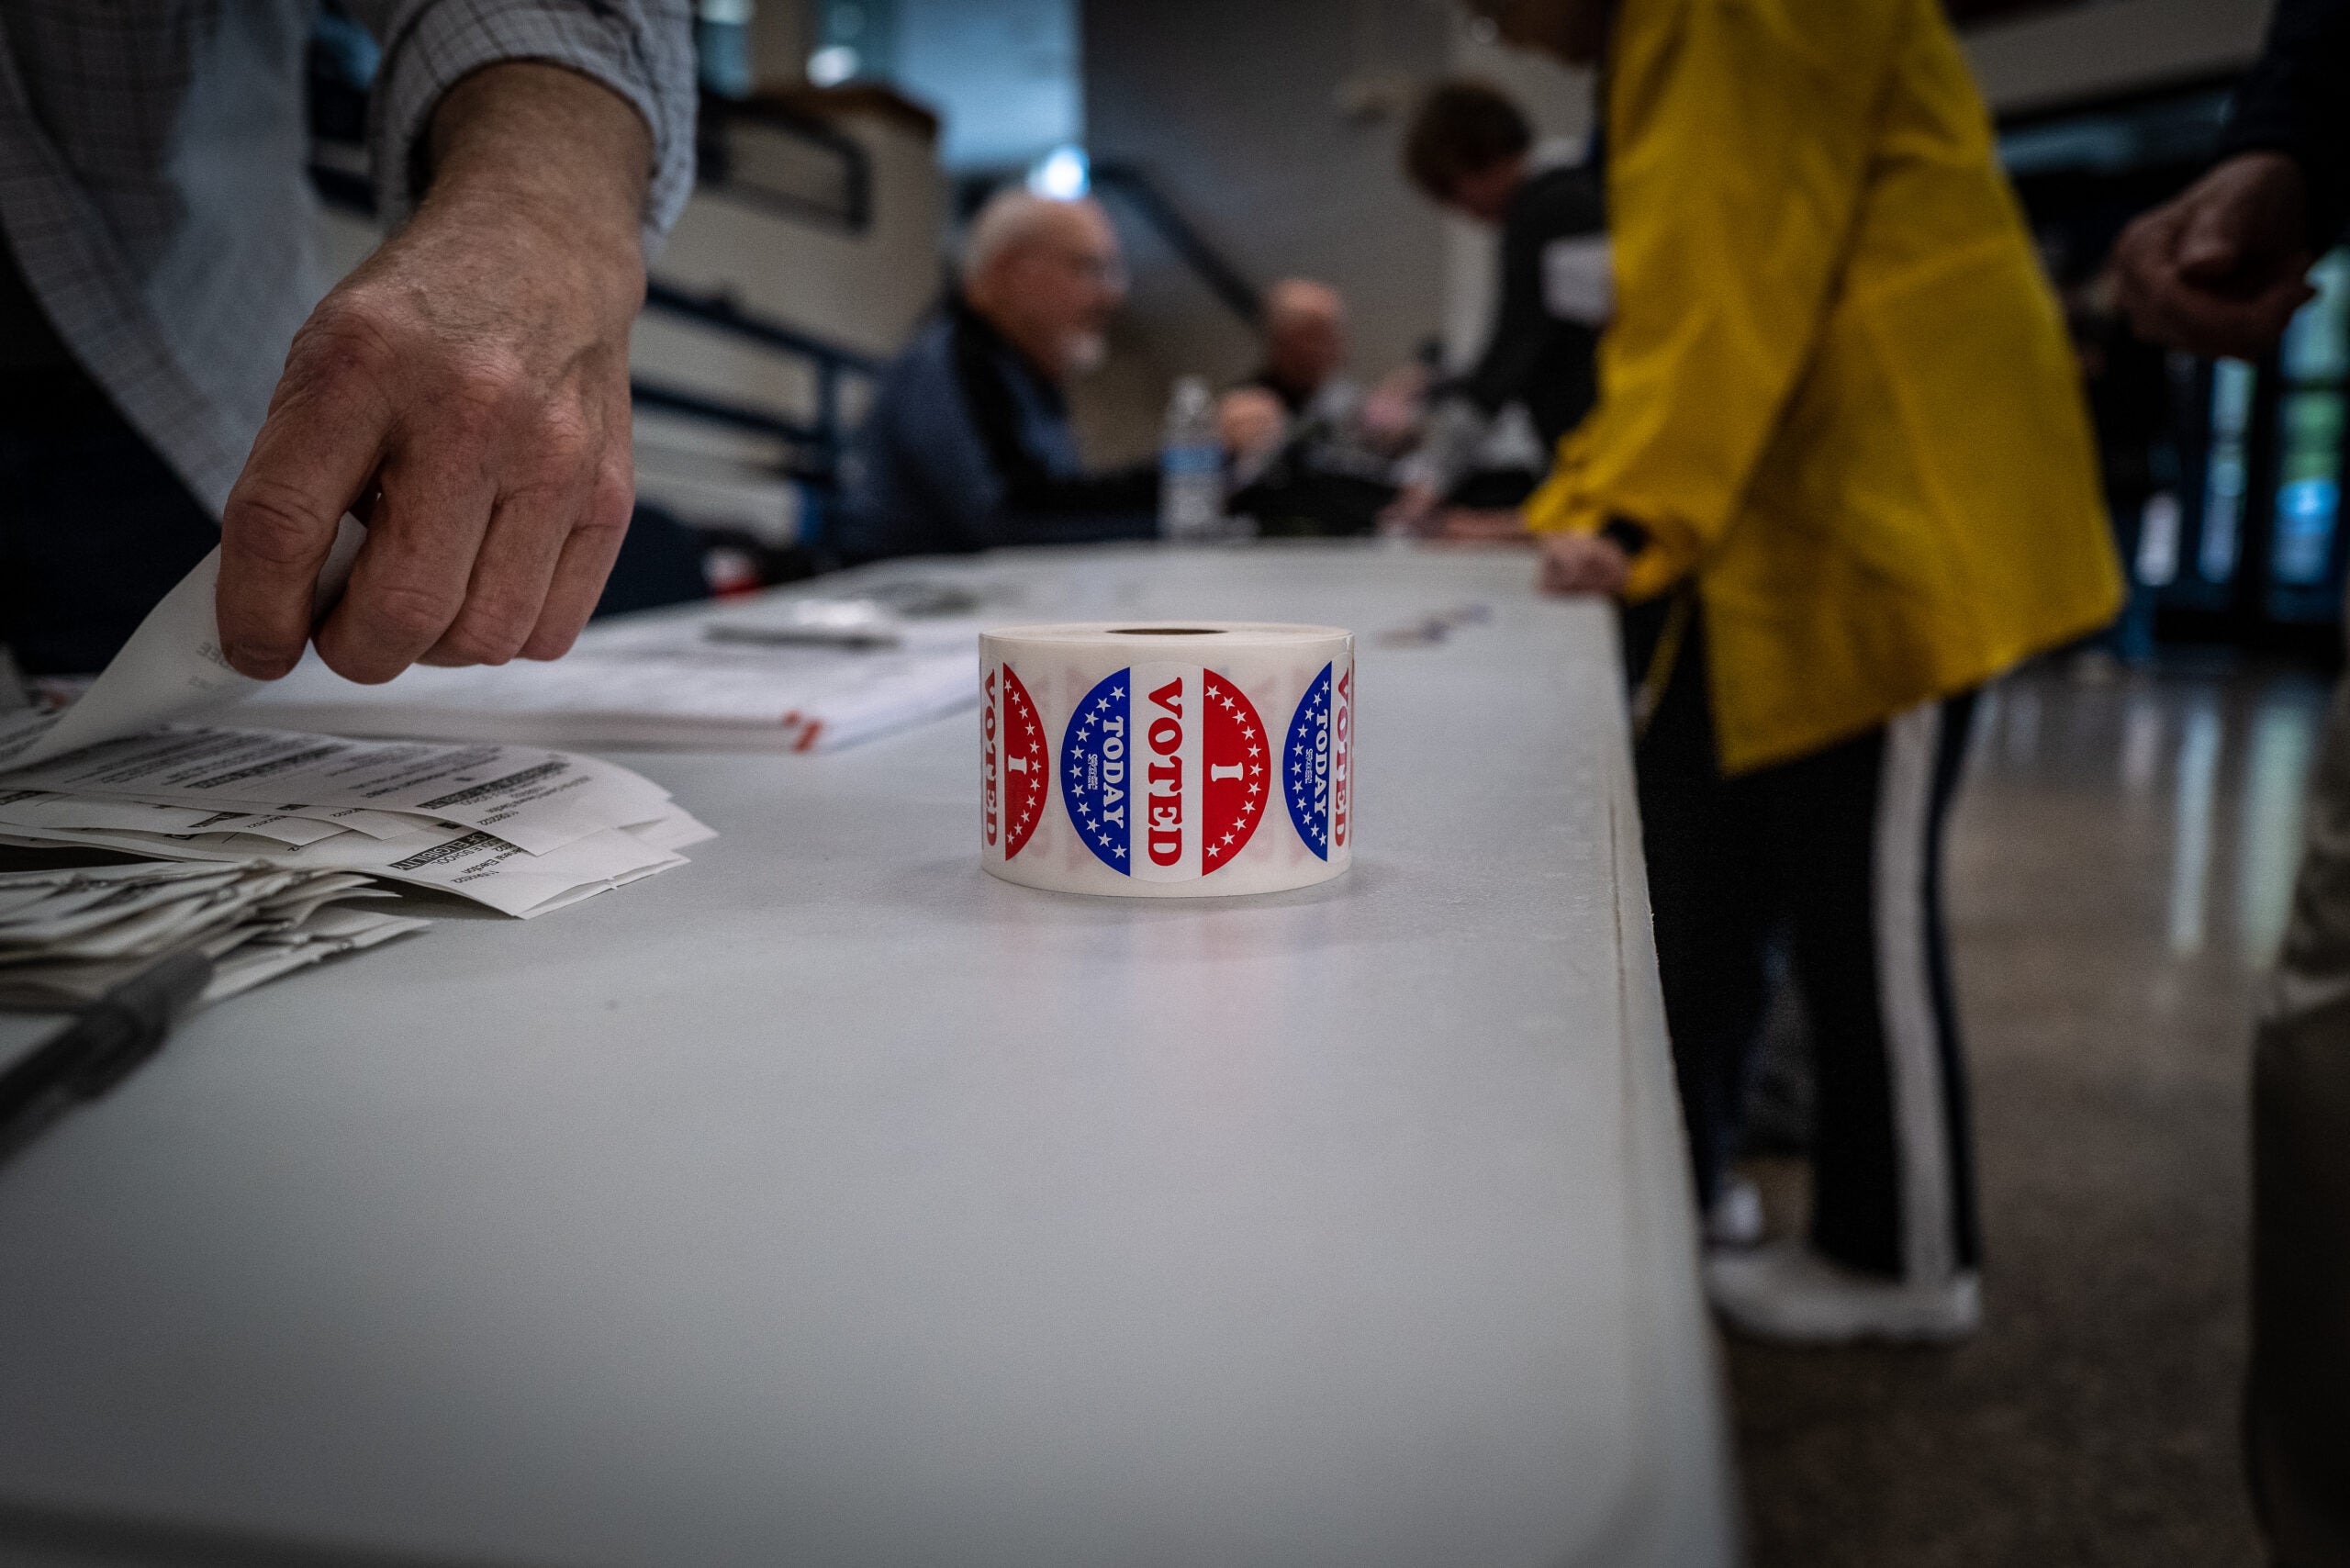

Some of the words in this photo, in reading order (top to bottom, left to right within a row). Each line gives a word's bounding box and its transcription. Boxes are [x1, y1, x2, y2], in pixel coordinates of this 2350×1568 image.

[984, 669, 997, 846] VOTED
[1007, 755, 1027, 776] I
[1102, 715, 1125, 829] TODAY
[1147, 677, 1183, 867] VOTED
[1211, 763, 1243, 782] I
[1313, 709, 1328, 818] TODAY
[1334, 667, 1349, 847] VOTED
[392, 840, 469, 869] ELIGIBILITY
